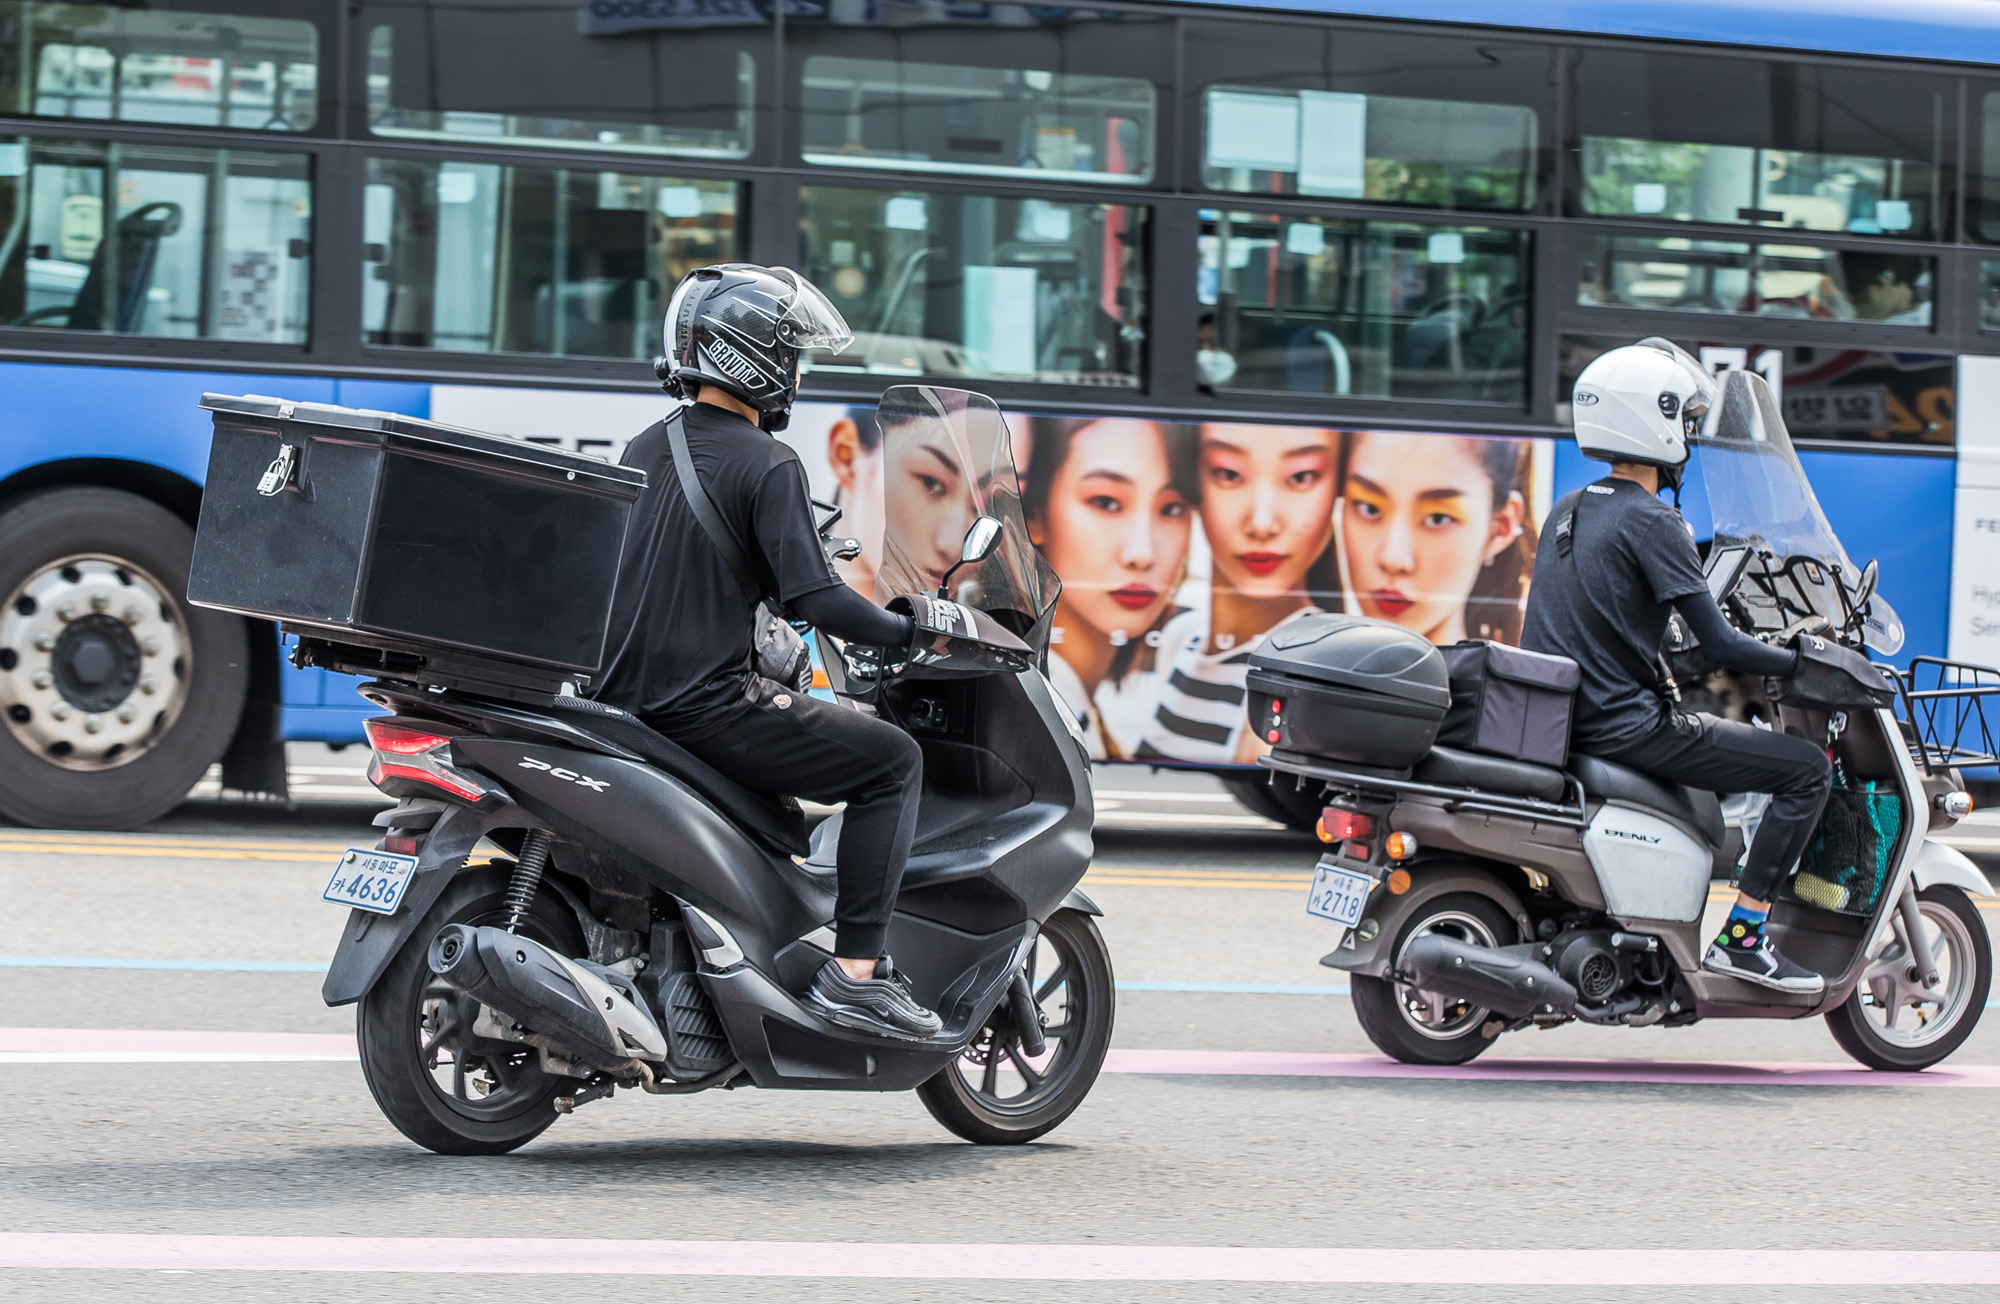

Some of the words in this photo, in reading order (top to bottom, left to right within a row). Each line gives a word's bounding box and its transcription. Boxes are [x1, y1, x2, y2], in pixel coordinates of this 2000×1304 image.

[708, 338, 759, 384] GRAVITY
[518, 756, 611, 793] PCX
[1604, 829, 1661, 844] BENLY
[362, 859, 378, 871] 서울
[378, 860, 398, 875] 마포
[331, 878, 346, 893] 카
[346, 873, 399, 904] 4636
[1321, 890, 1360, 918] 2718
